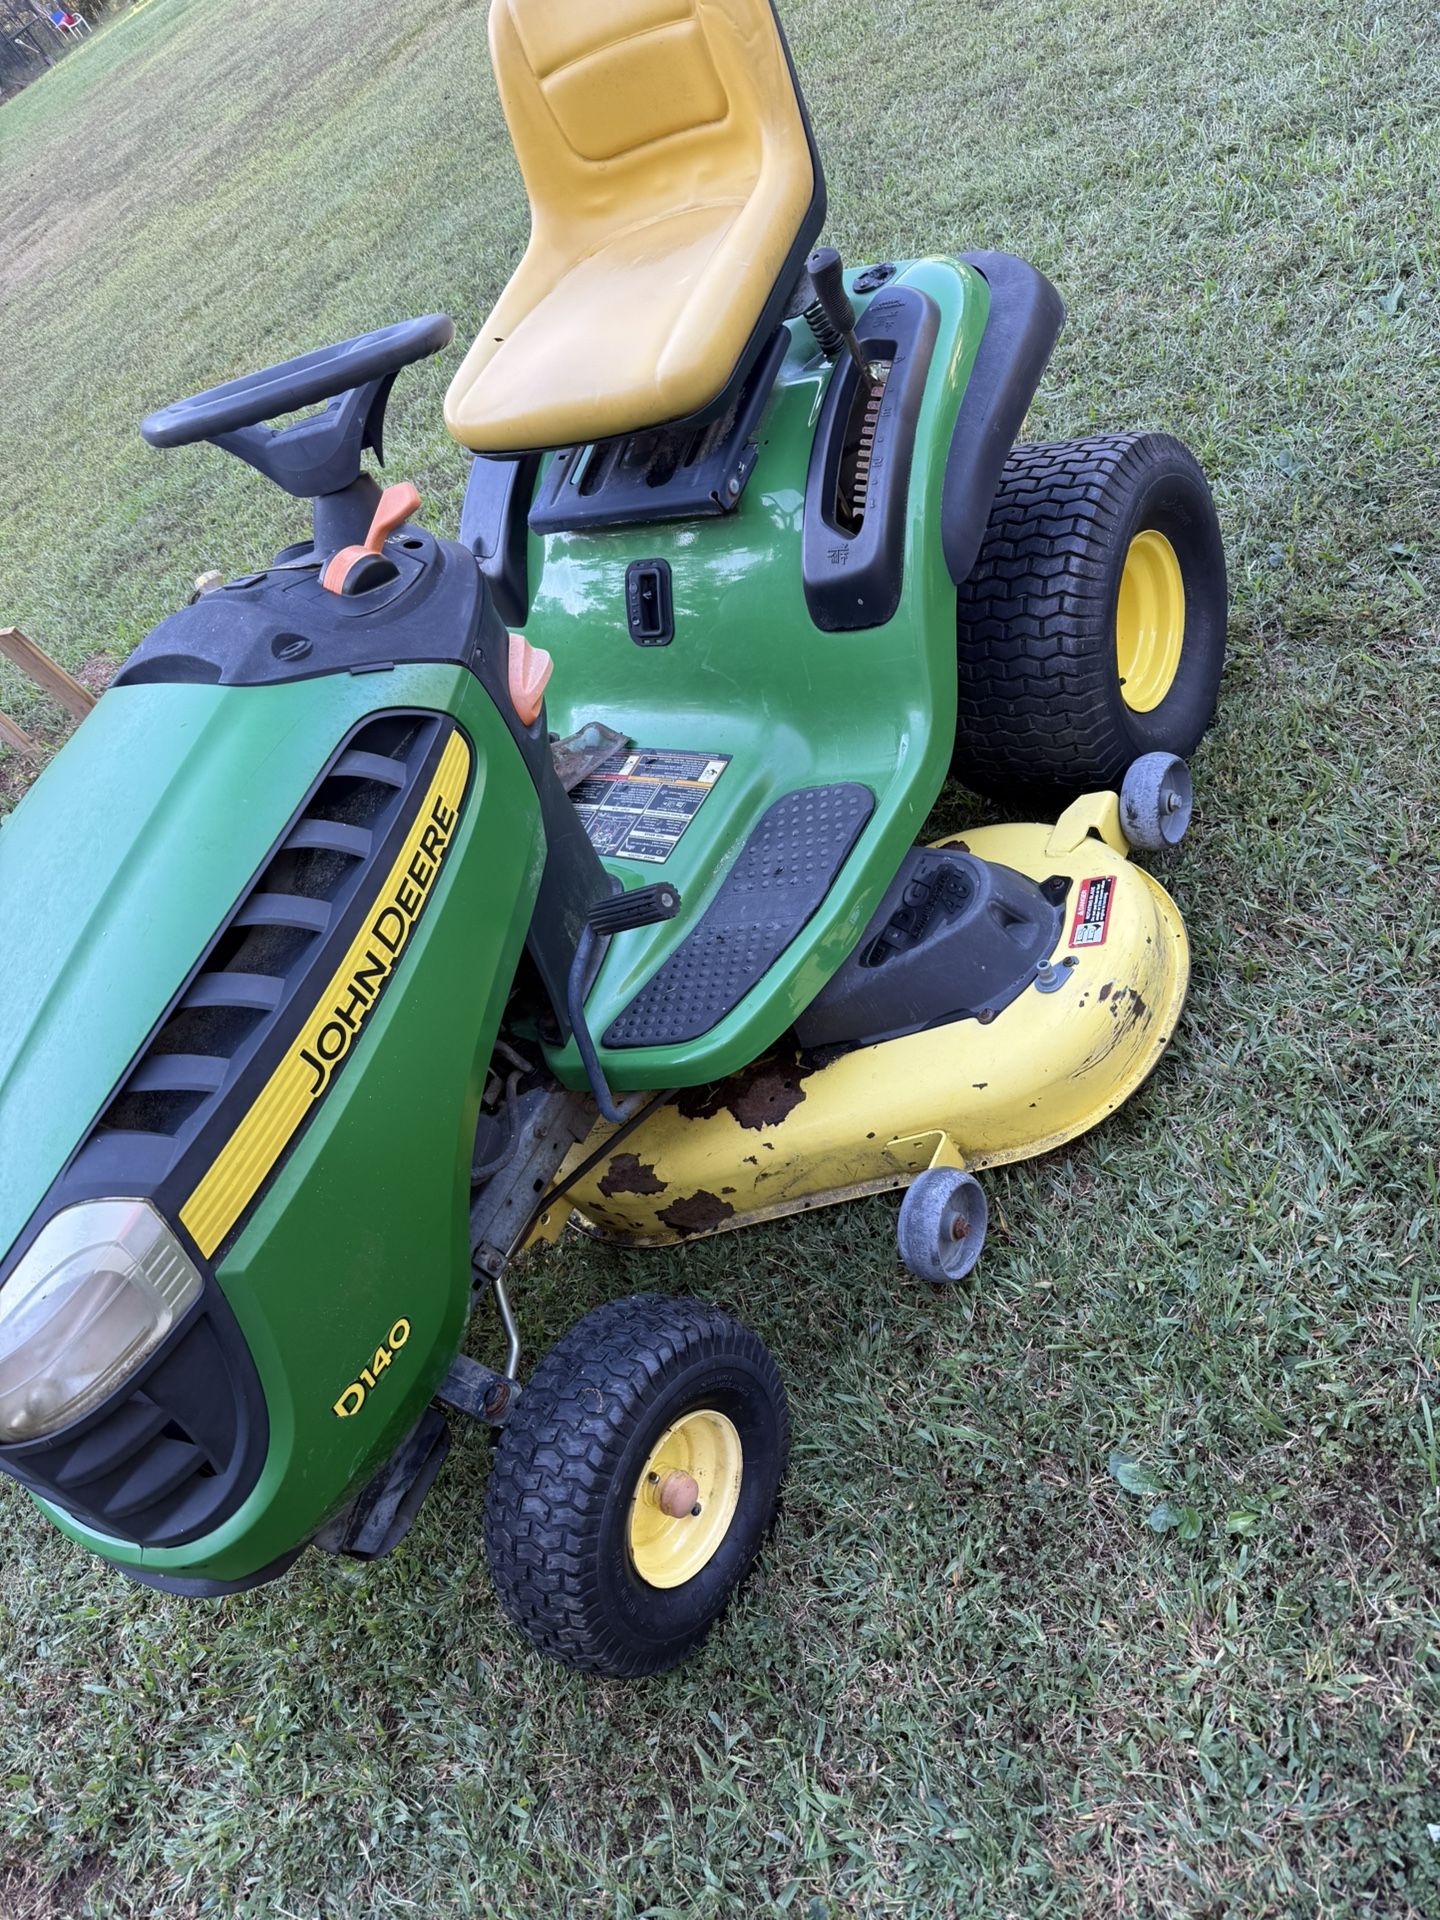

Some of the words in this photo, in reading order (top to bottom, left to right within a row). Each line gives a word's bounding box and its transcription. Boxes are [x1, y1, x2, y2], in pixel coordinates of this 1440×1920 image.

[300, 949, 389, 1095] JOHN
[372, 794, 456, 955] DEERE
[332, 1317, 411, 1417] D140
